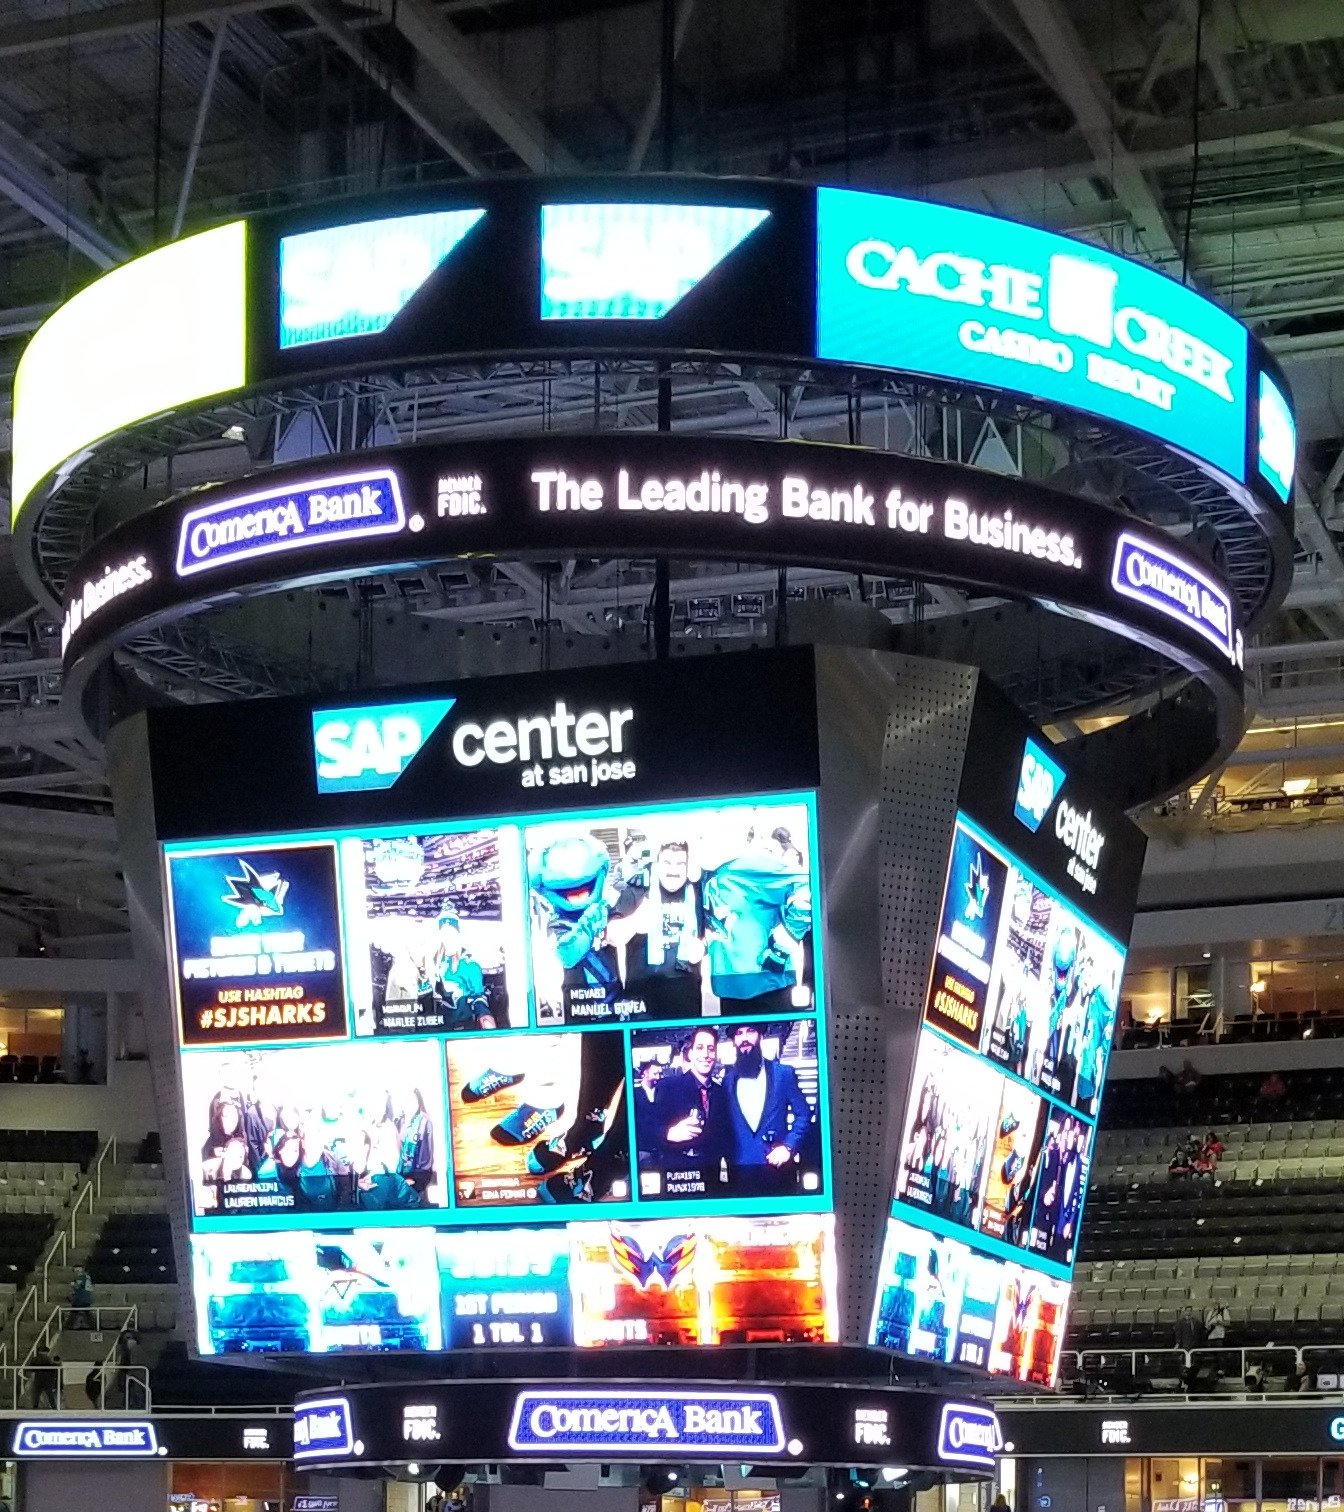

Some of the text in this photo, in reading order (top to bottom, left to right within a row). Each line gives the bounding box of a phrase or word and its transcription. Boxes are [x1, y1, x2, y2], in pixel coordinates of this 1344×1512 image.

[846, 238, 1234, 403] CACHE CREEK
[958, 320, 1074, 373] CASINO
[307, 484, 384, 525] Bank
[530, 467, 1083, 569] The Leading Bank for Business.
[313, 699, 635, 779] SAP center
[521, 758, 637, 788] at san jose
[1055, 799, 1106, 871] center
[199, 1001, 327, 1030] #SJSHARKS
[244, 985, 305, 1003] HASHTAG
[682, 1405, 763, 1435] Bank
